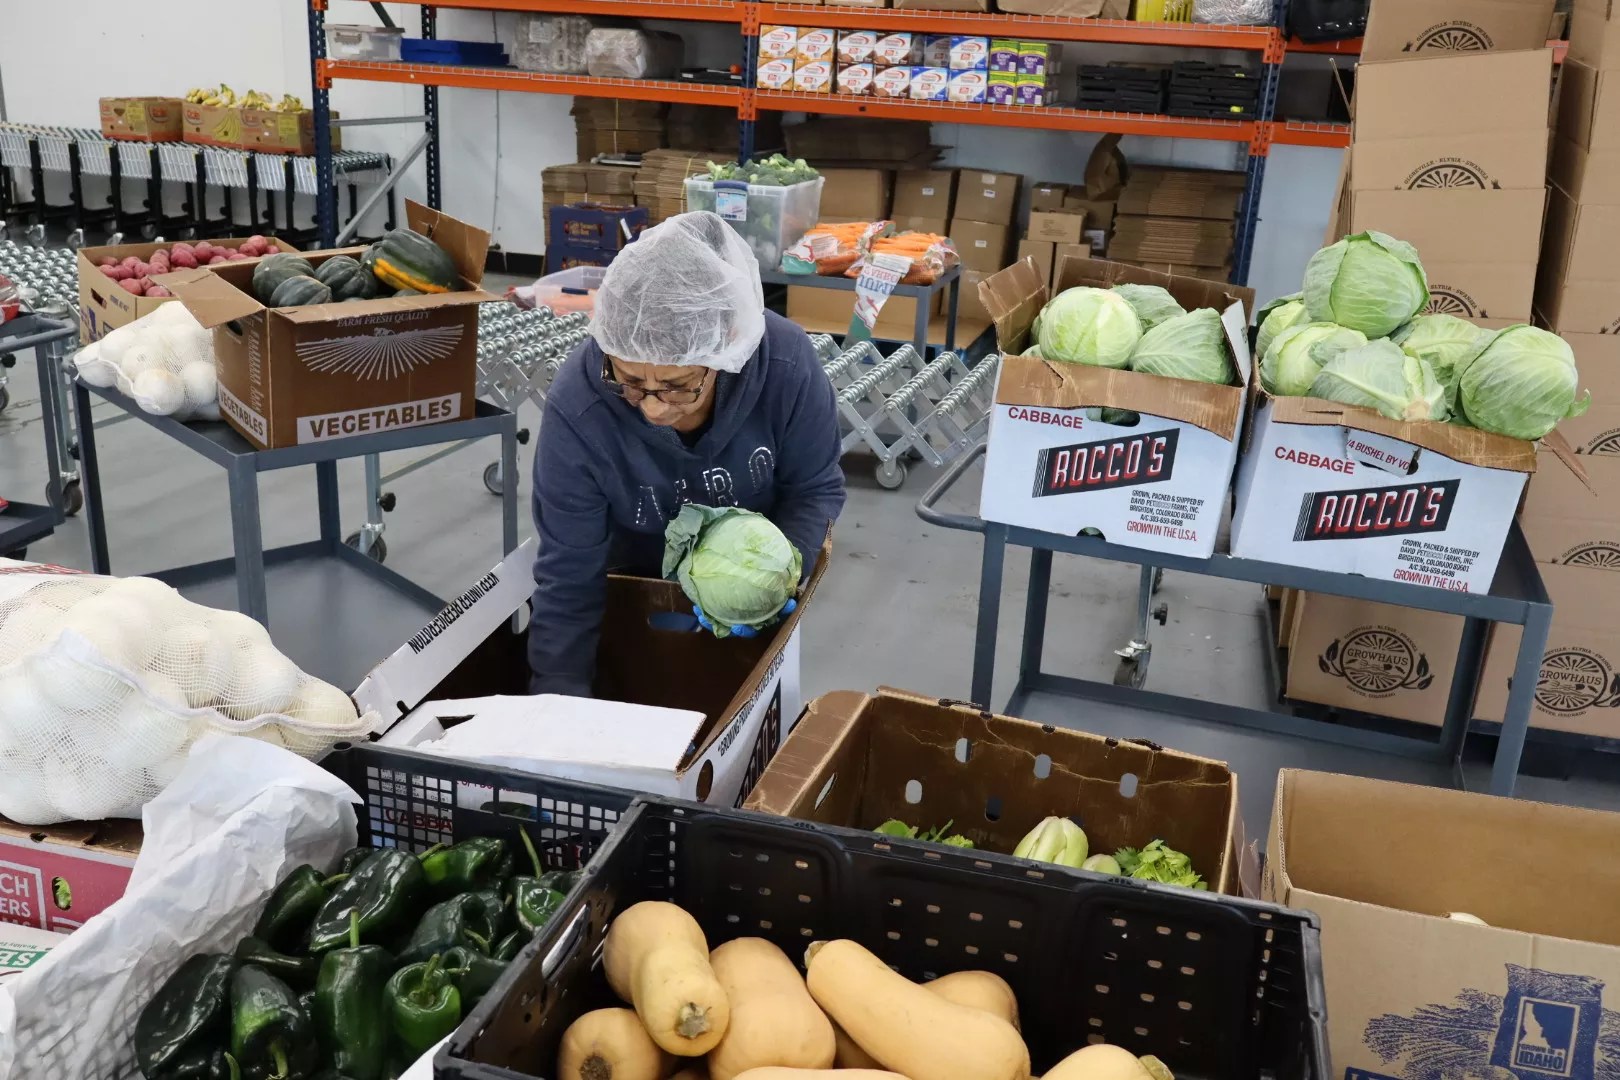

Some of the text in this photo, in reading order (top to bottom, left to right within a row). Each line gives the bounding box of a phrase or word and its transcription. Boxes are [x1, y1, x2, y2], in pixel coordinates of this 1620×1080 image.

[337, 311, 430, 328] FARM FRESH QUALITY
[220, 390, 265, 437] VEGETABLES
[310, 398, 452, 439] VEGETABLES
[1008, 406, 1084, 430] CABBAGE
[1052, 436, 1166, 489] ROCCO'S
[1275, 446, 1356, 475] CABBAGE
[1355, 442, 1385, 460] BUSHEL
[1385, 455, 1398, 465] BY
[1132, 490, 1151, 499] GROWN,
[1152, 492, 1172, 502] PACKED
[1176, 496, 1198, 506] SHIPPED
[1197, 499, 1205, 507] BY
[1130, 505, 1155, 515] BRIGHTON,
[1155, 508, 1181, 518] COLORADO
[1315, 485, 1446, 534] ROCCO'S
[1127, 521, 1154, 535] GROWN
[1154, 525, 1162, 536] IN
[1163, 526, 1178, 539] THE
[1400, 546, 1415, 554] DAVID
[1443, 554, 1462, 564] FARMS,
[1402, 539, 1422, 549] GROWN,
[1423, 542, 1445, 552] PACKED
[1449, 547, 1472, 557] SHIPPED
[1398, 554, 1425, 565] BRIGHTON,
[1425, 559, 1453, 569] COLORADO
[1393, 568, 1422, 583] GROWN
[1422, 574, 1431, 585] IN
[1432, 576, 1448, 589] THE
[408, 572, 500, 655] KEEP UNDER REFRIGERATION
[1347, 648, 1409, 667] GROWHAUS
[1538, 669, 1602, 686] GROWHAUS
[1518, 1051, 1564, 1071] IDAHO
